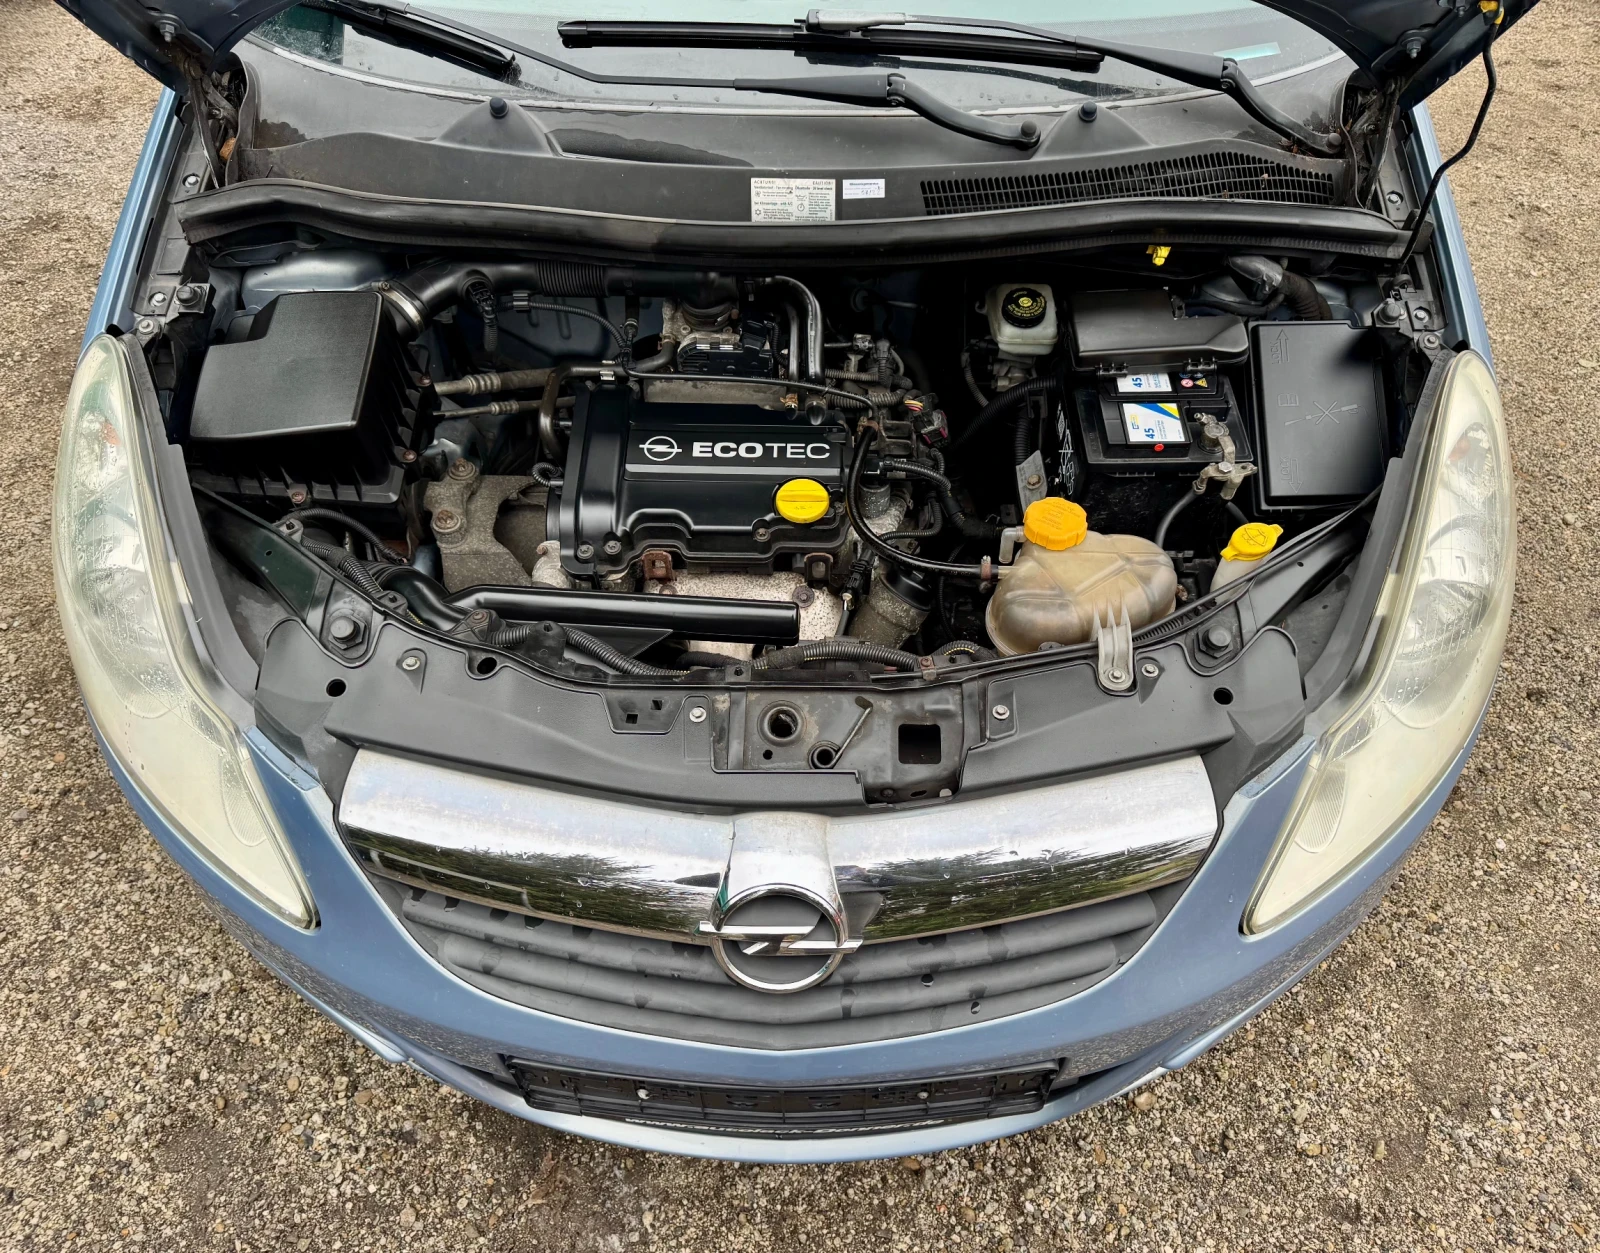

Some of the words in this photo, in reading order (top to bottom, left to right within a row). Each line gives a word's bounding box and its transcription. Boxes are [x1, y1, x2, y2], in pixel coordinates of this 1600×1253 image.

[1131, 377, 1142, 388] 45
[1144, 427, 1156, 439] 45
[692, 441, 831, 459] ECOTEC
